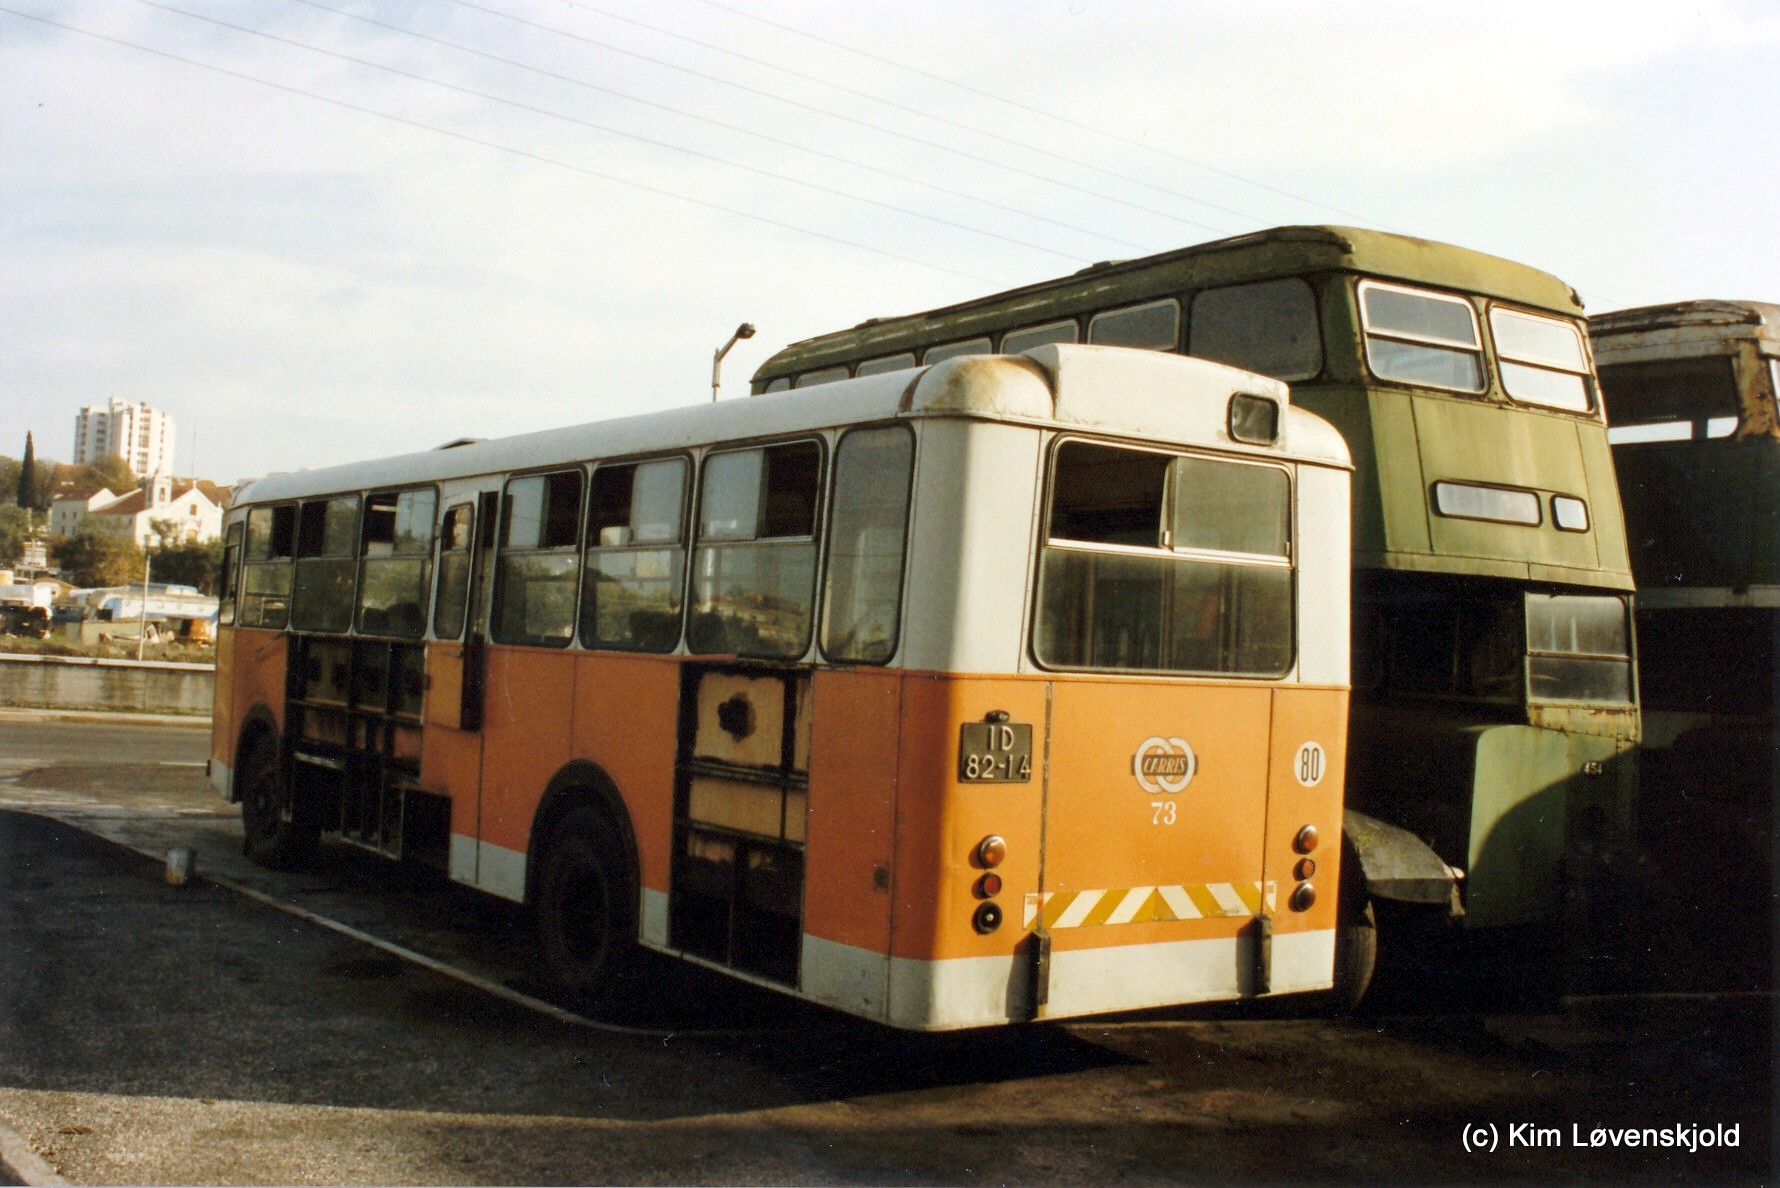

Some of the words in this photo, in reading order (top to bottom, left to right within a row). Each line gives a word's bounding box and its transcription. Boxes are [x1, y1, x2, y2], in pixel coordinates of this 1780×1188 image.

[990, 725, 1015, 751] ID
[966, 754, 1031, 779] 82-14
[1143, 757, 1187, 774] CARRIS
[1301, 747, 1320, 782] 80
[1151, 800, 1177, 825] 73
